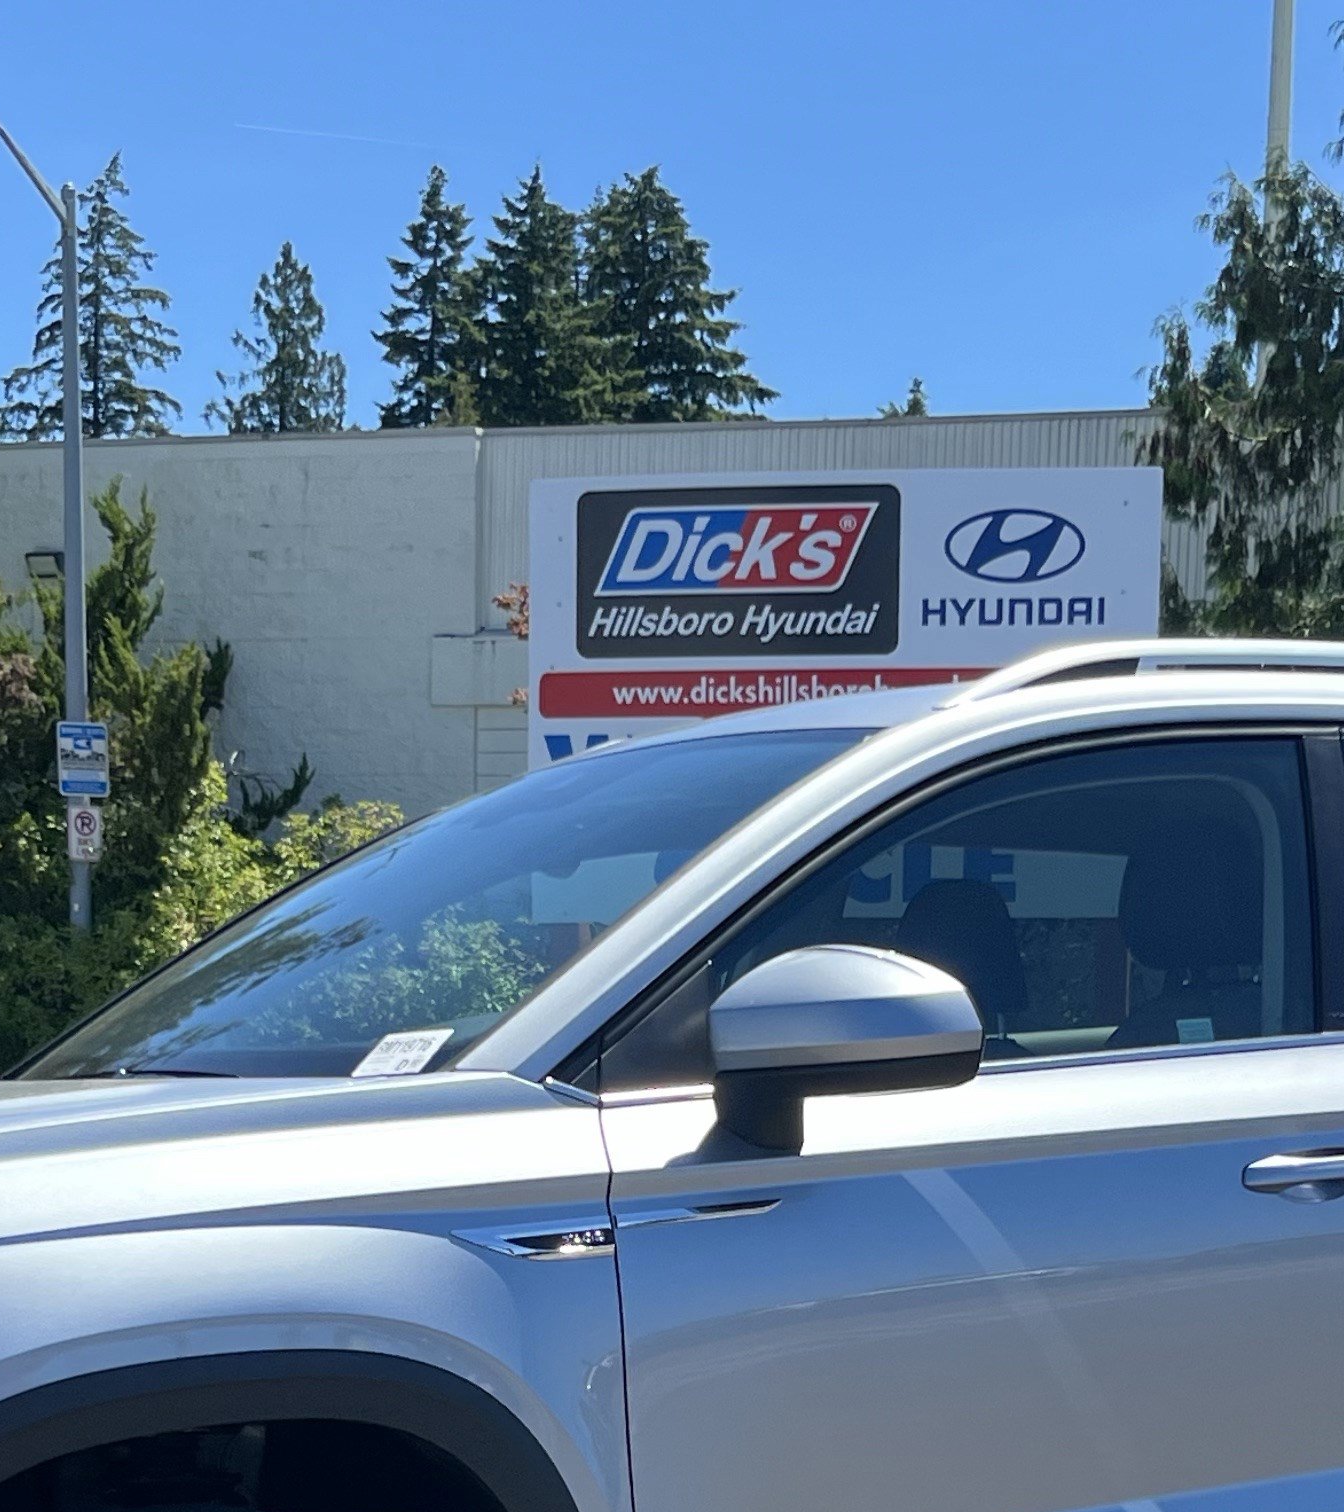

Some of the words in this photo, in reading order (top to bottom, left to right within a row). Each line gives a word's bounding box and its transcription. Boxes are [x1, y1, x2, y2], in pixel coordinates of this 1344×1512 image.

[588, 606, 735, 639] Hillsboro
[740, 603, 881, 643] Hyundai
[921, 596, 1105, 627] HYUNDAI
